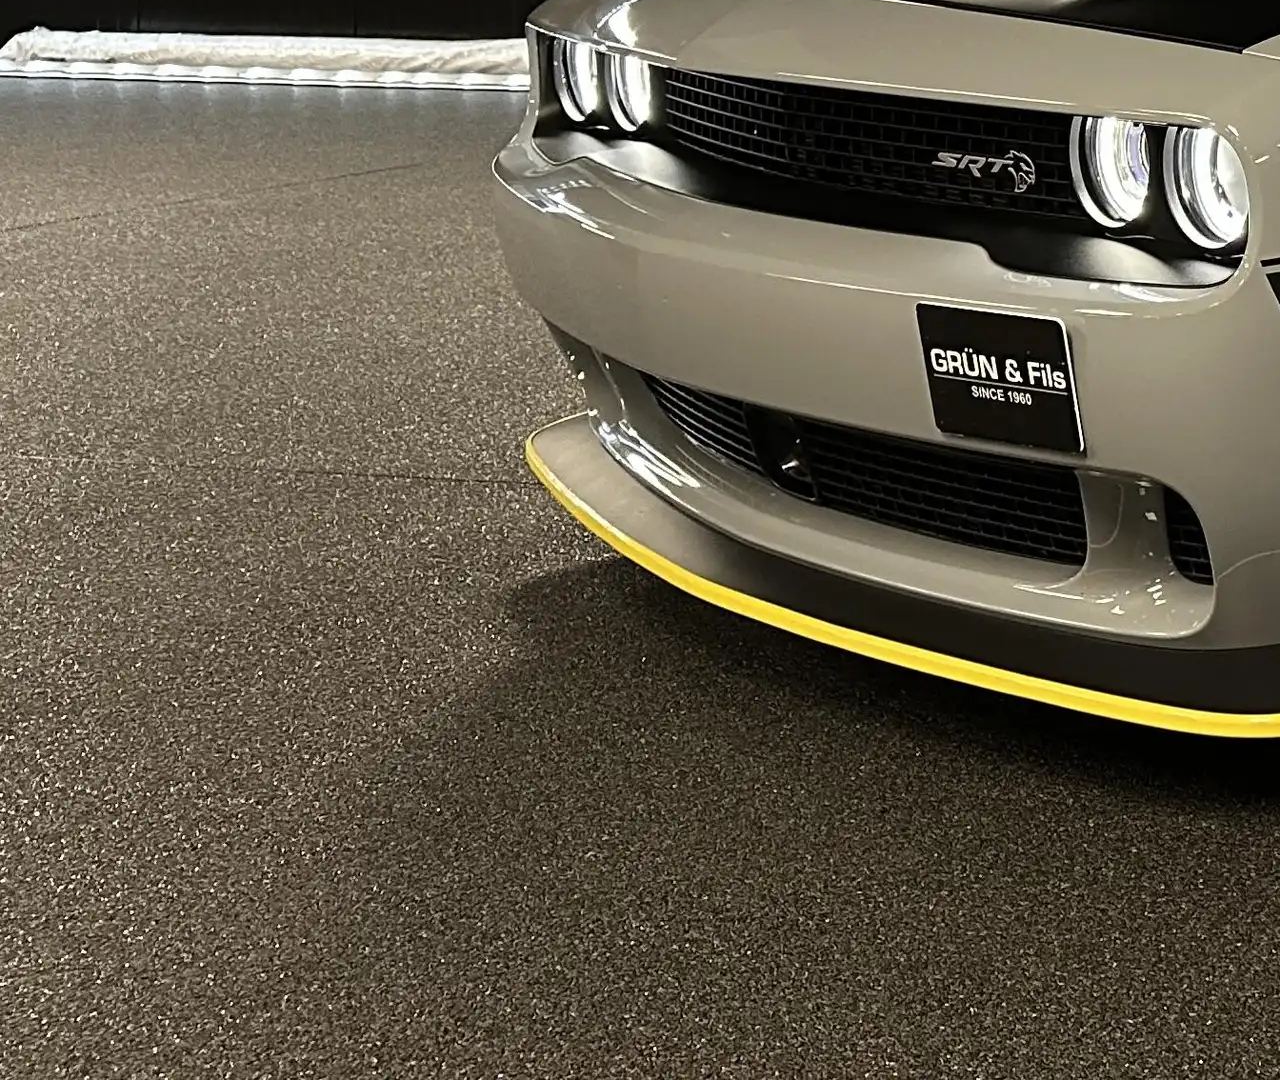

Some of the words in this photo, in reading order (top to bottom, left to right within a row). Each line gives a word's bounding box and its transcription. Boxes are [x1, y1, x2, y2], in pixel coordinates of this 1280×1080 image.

[931, 152, 1014, 178] SRT
[930, 347, 999, 380] GRÜN
[1005, 358, 1023, 383] &
[1027, 361, 1066, 389] Fils
[971, 385, 1005, 402] SINCE
[1007, 390, 1032, 406] 1960
